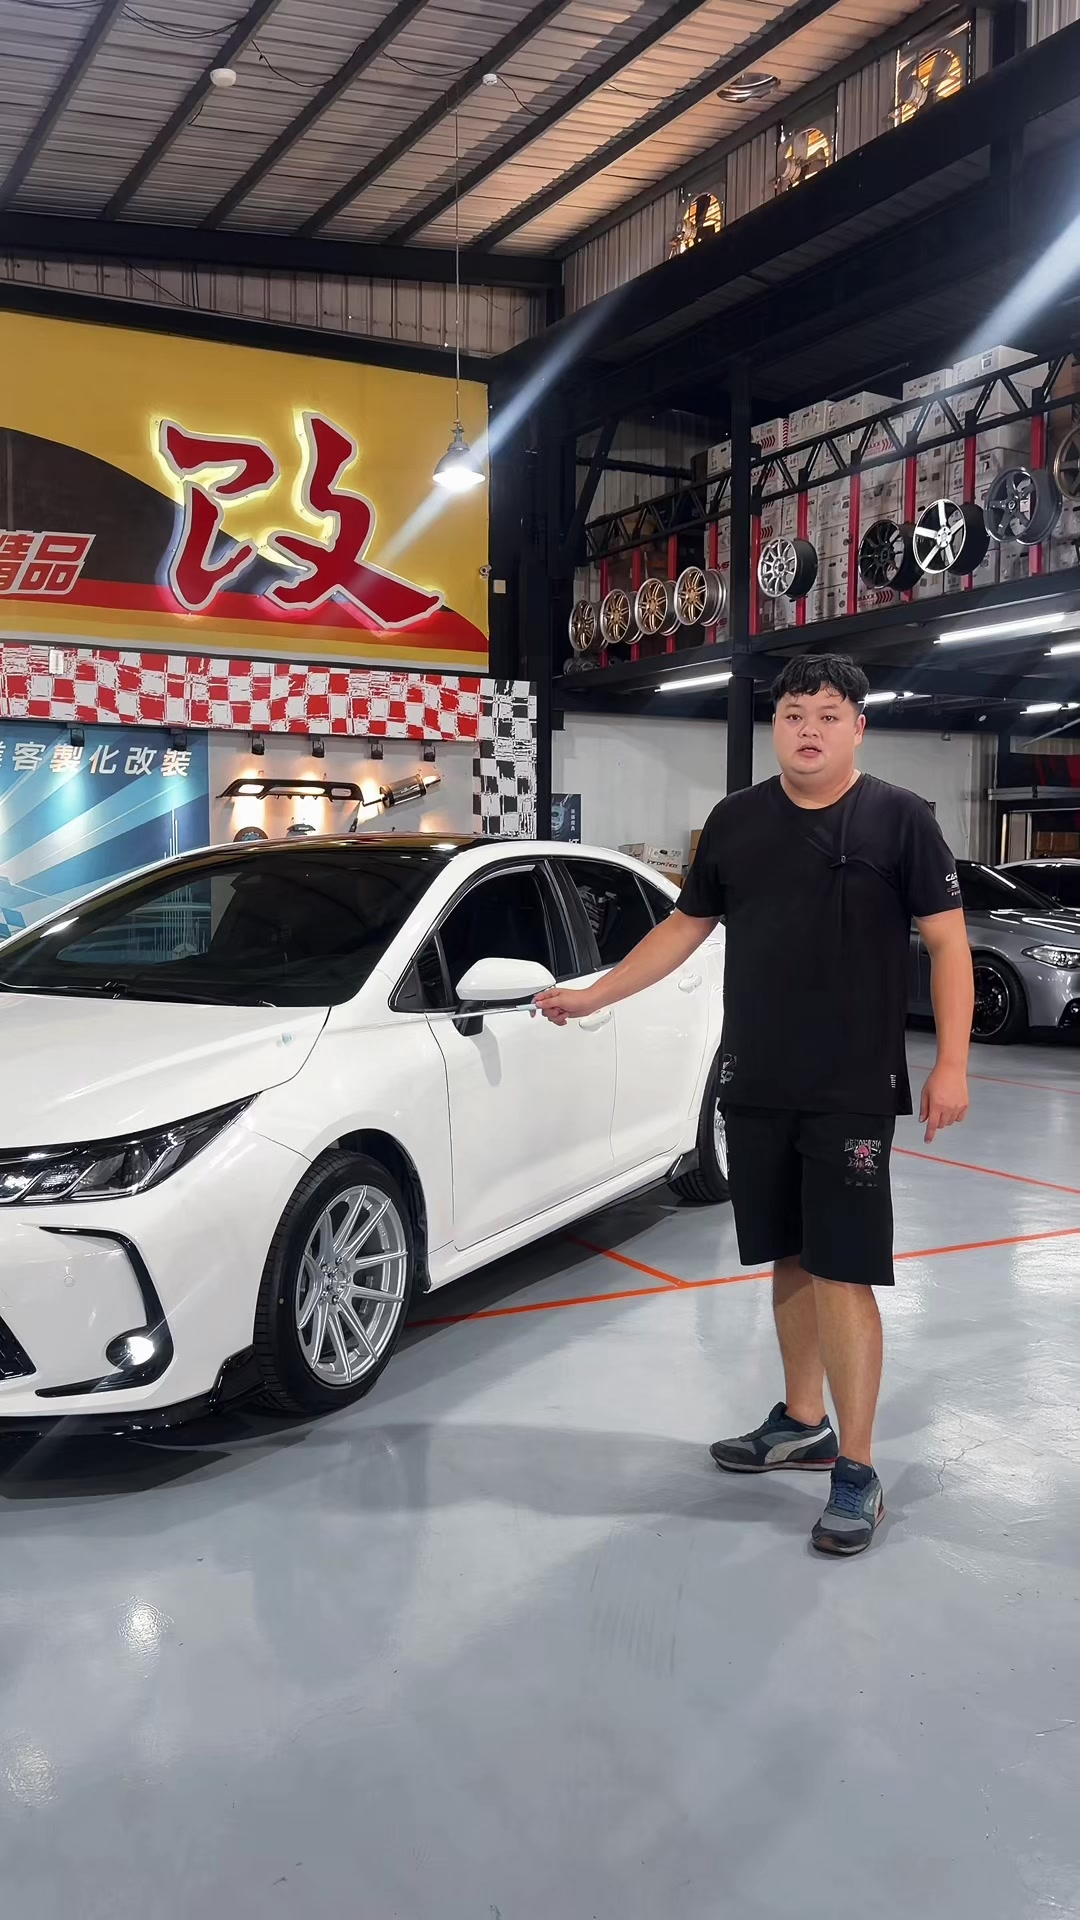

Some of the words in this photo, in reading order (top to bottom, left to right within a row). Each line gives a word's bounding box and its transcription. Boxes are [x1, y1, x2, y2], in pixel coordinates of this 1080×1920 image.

[159, 411, 446, 629] 改
[0, 741, 192, 777] 客製化改裝
